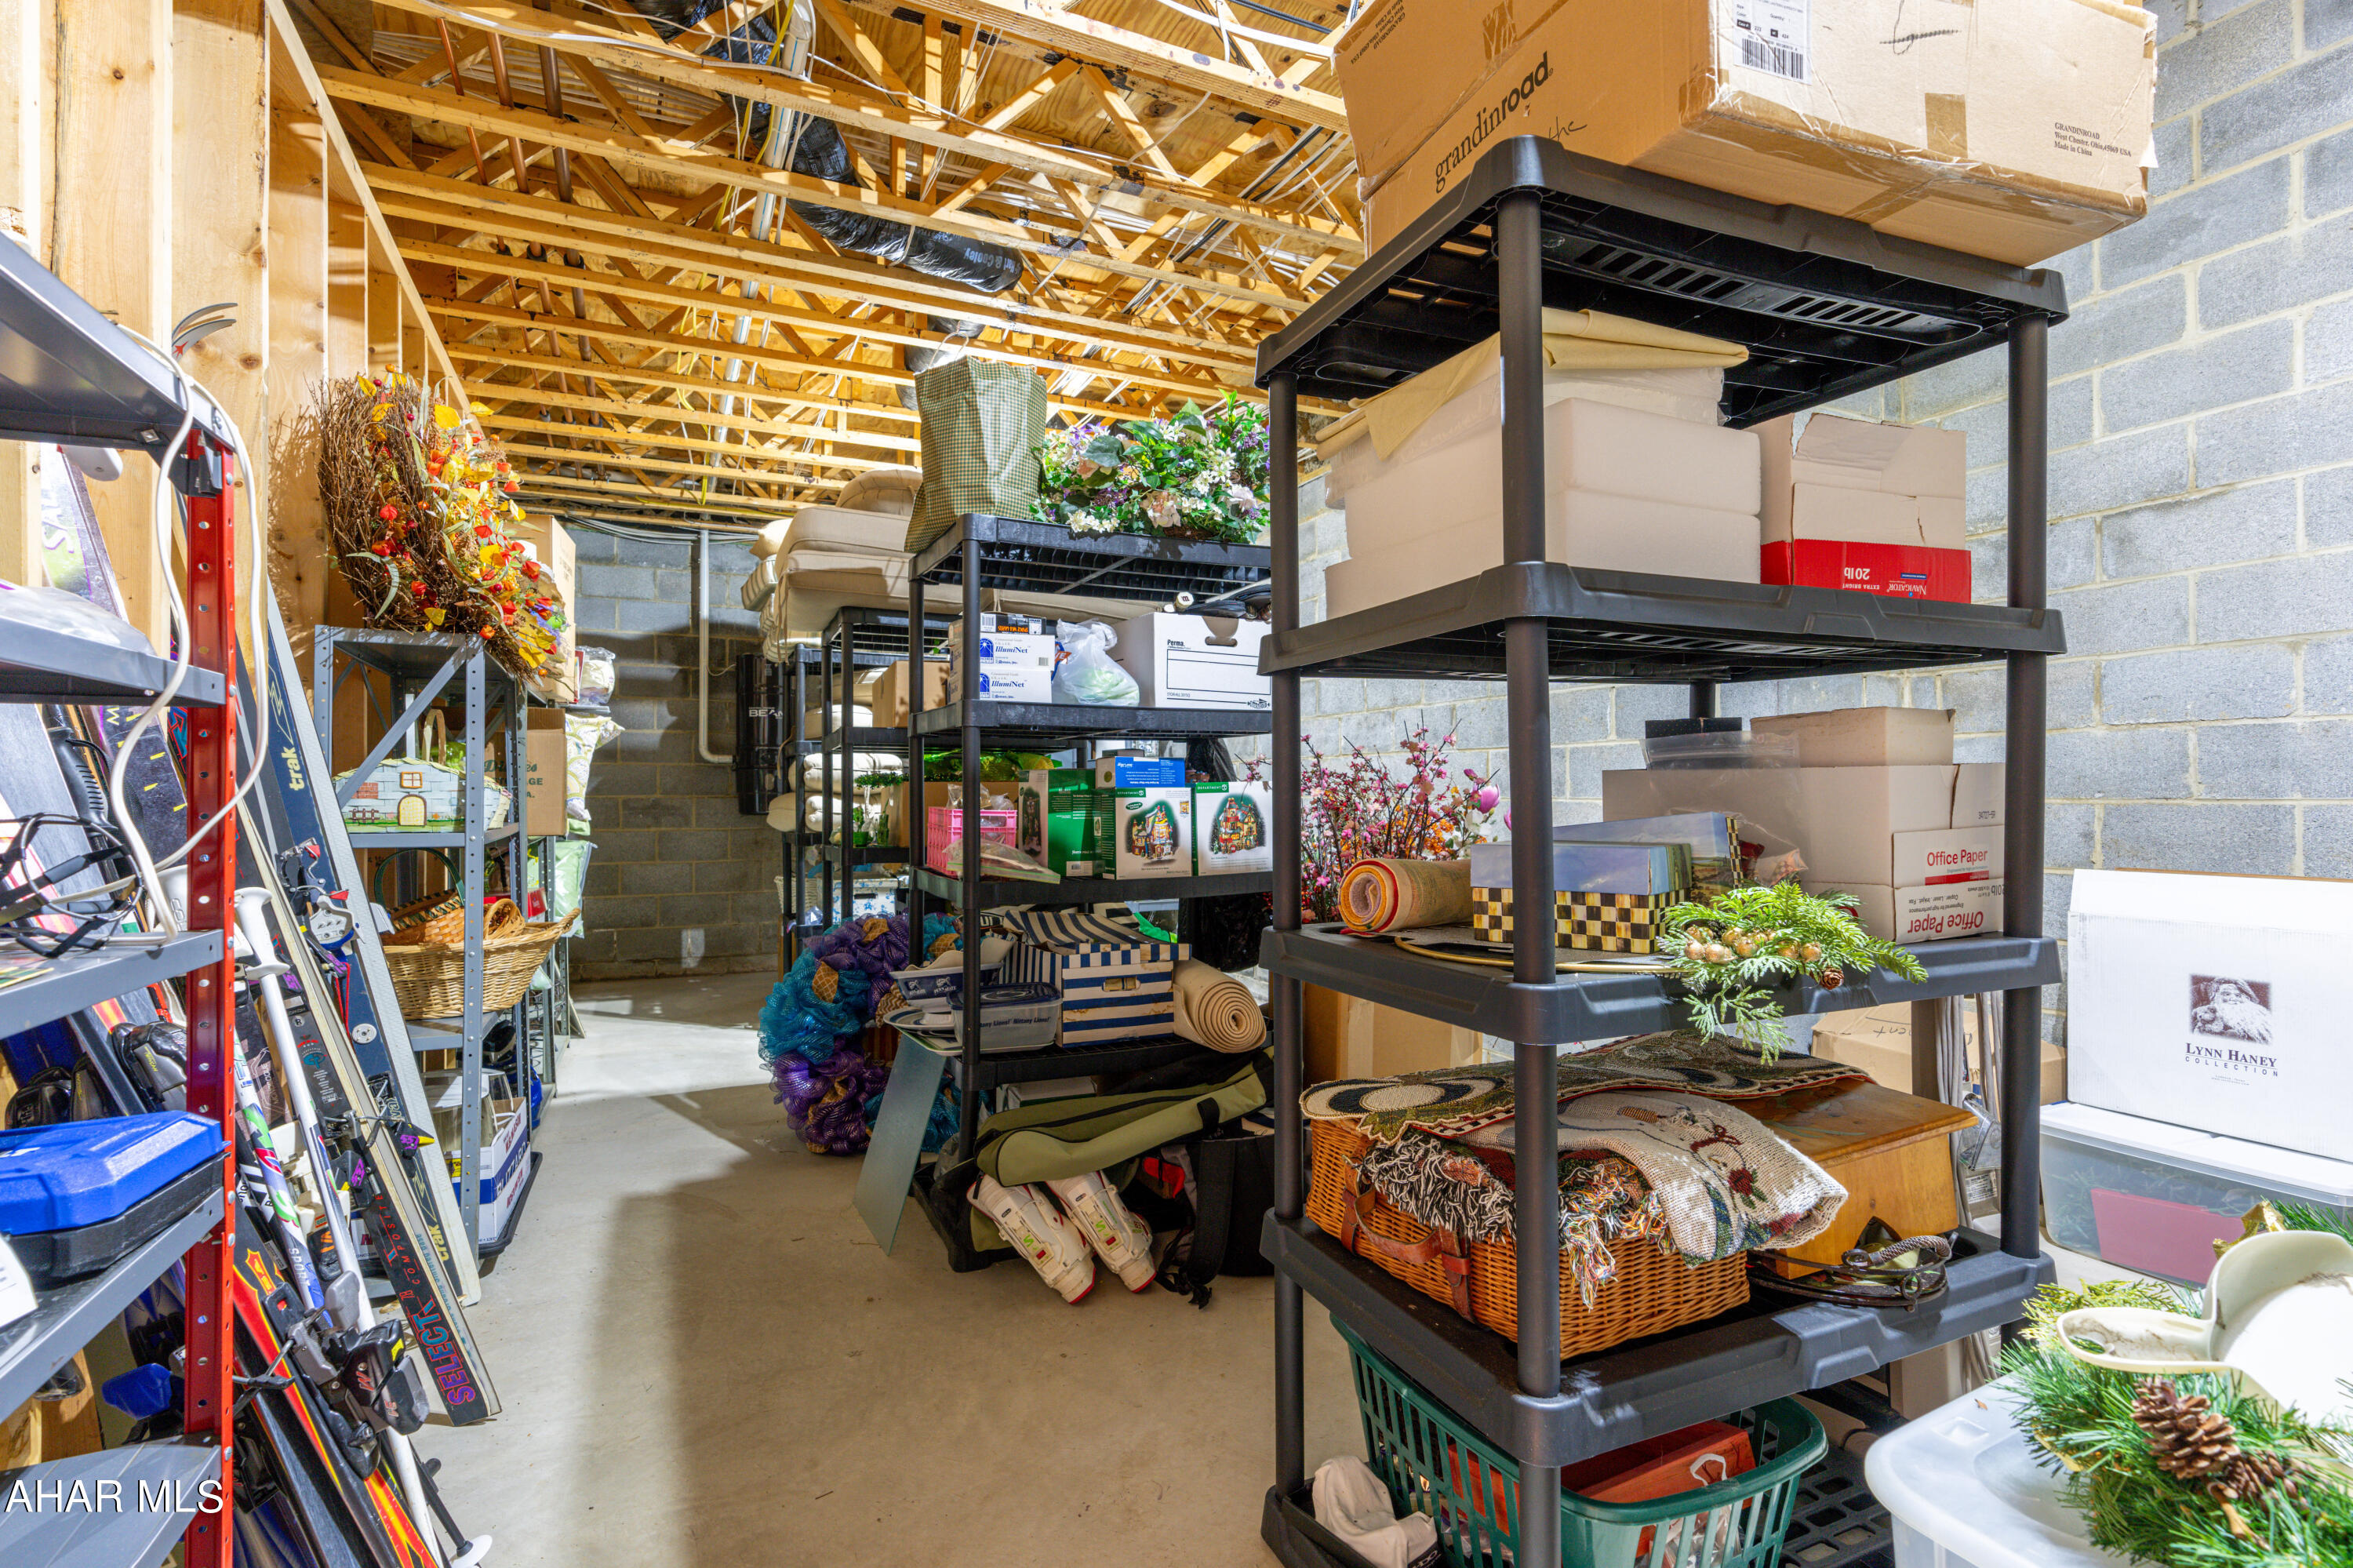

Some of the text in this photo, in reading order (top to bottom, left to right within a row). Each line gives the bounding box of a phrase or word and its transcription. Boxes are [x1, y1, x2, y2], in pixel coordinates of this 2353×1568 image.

[1374, 13, 1405, 49] GRANDINROAD
[2055, 122, 2100, 140] GRANDINROAD
[2054, 140, 2069, 151] Made
[2077, 146, 2093, 156] China
[2055, 132, 2068, 141] West
[2119, 148, 2132, 157] USA
[963, 248, 995, 267] Cooley
[281, 747, 305, 791] trak
[1927, 849, 1988, 866] Office Paper
[1907, 911, 1984, 933] Office Paper
[2185, 1056, 2278, 1077] COLLECTION
[2186, 1042, 2277, 1067] LYNN HANEY
[375, 1195, 420, 1285] COMPOSITE
[289, 1247, 311, 1287] SPORT
[412, 1312, 476, 1406] SELECT
